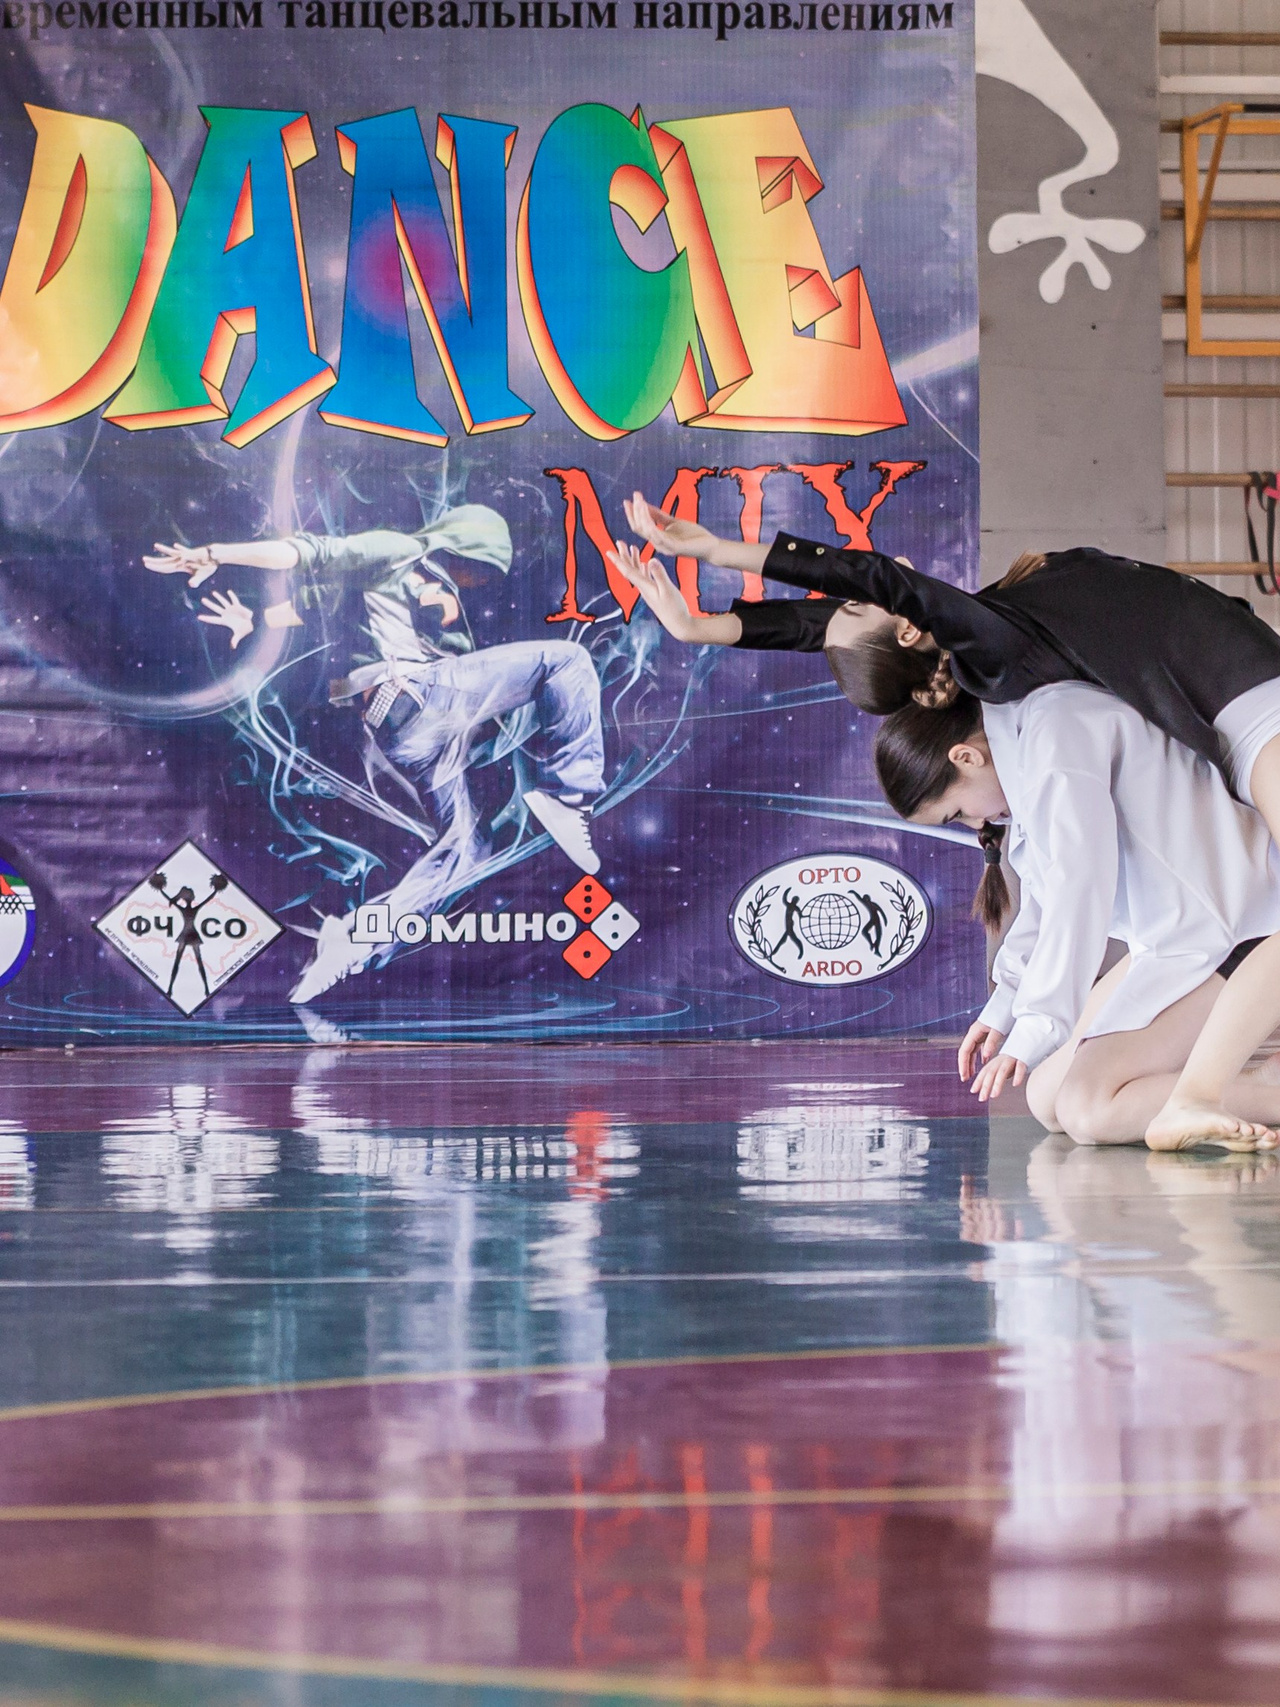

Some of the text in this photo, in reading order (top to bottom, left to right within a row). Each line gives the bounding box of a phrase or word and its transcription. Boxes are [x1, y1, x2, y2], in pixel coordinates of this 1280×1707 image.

[2, 0, 954, 41] временным танцевальным направлениям
[0, 102, 908, 448] DANCE
[351, 904, 578, 943] Домино
[801, 960, 863, 977] ARDO
